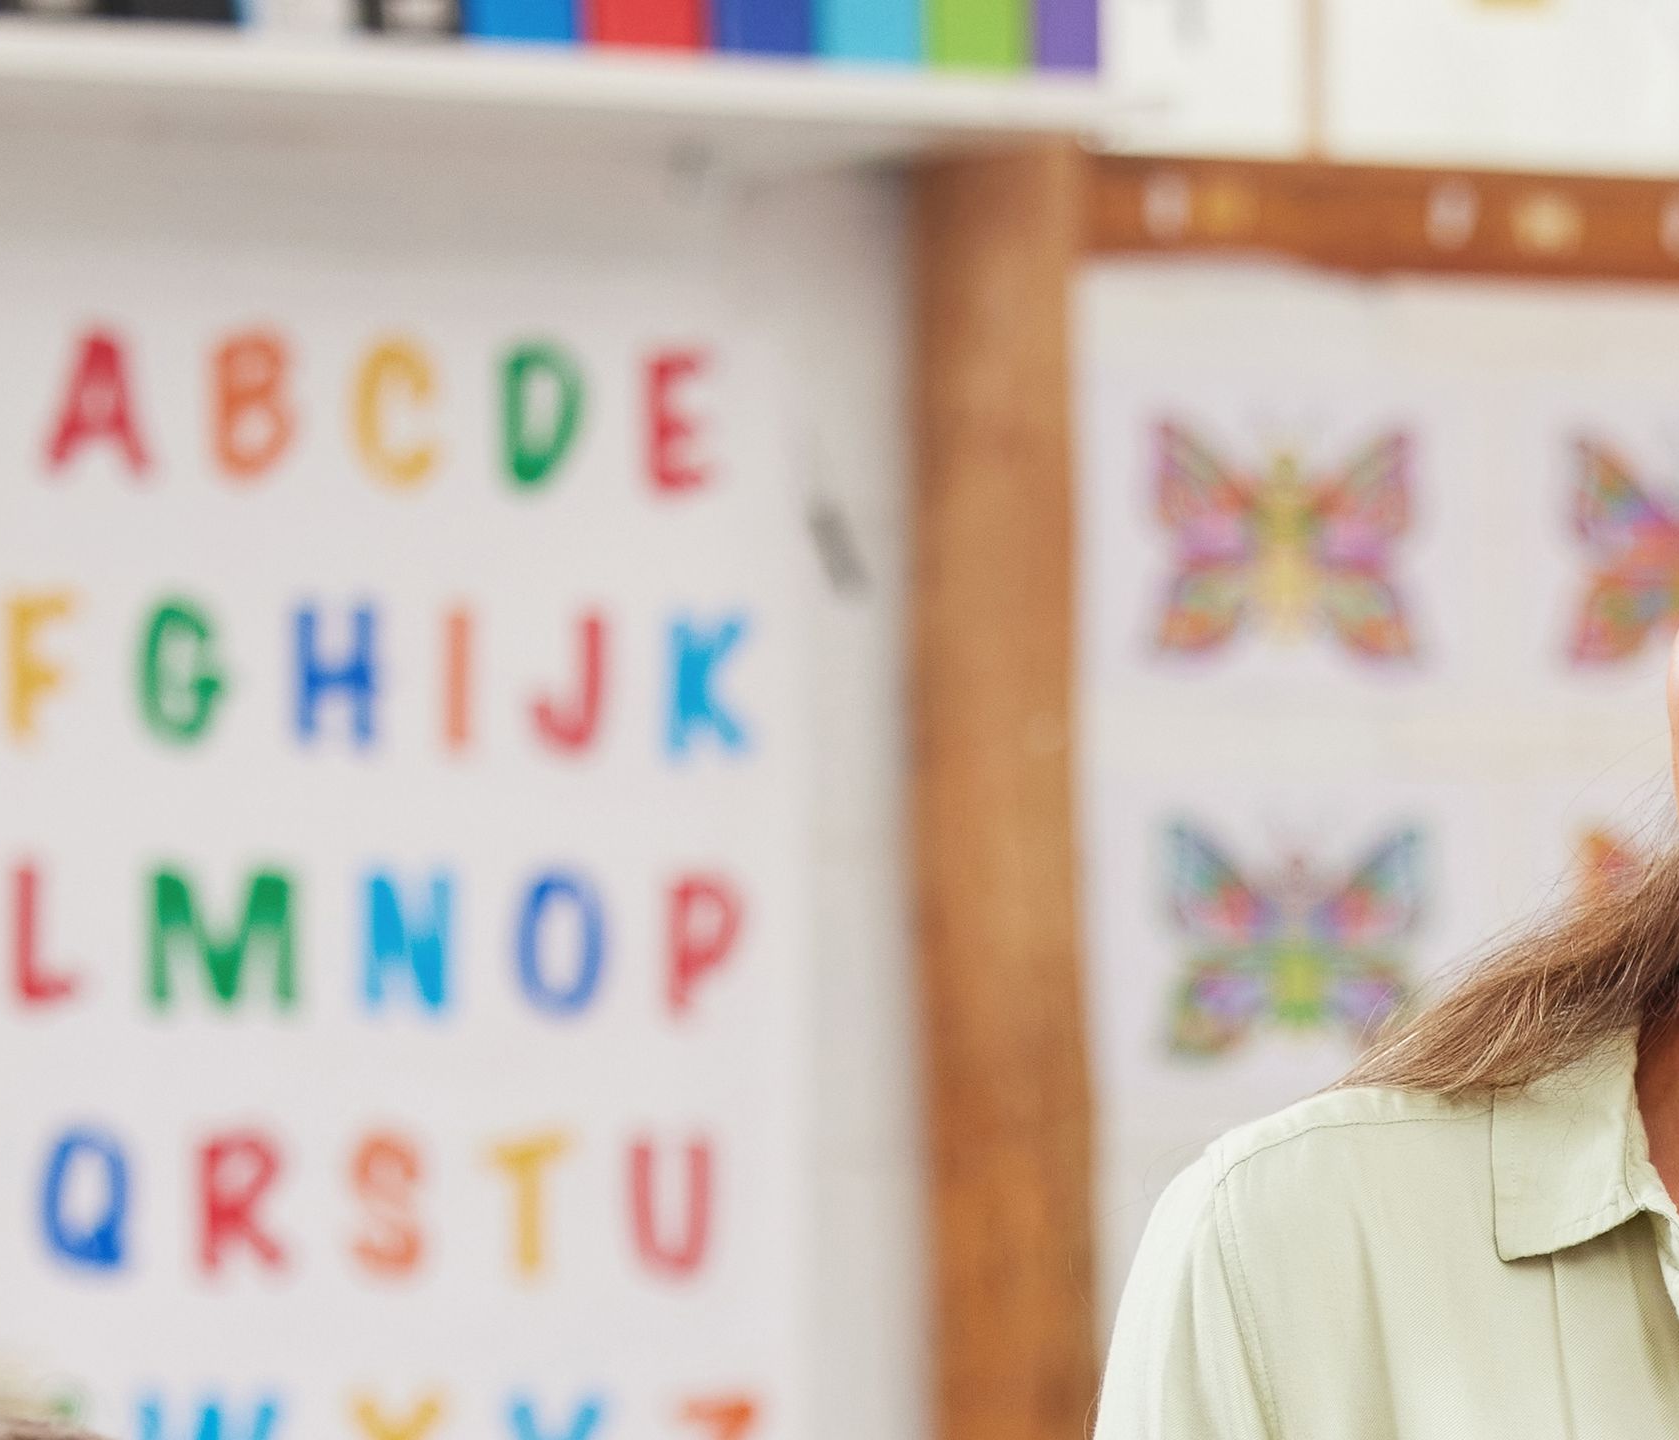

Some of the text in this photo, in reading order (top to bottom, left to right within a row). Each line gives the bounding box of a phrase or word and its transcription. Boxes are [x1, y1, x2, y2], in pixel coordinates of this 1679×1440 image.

[42, 322, 713, 498] A B C D E
[0, 588, 749, 758] F G H I J K
[10, 863, 745, 1018] L M N O P
[39, 1128, 715, 1280] Q R S T U
